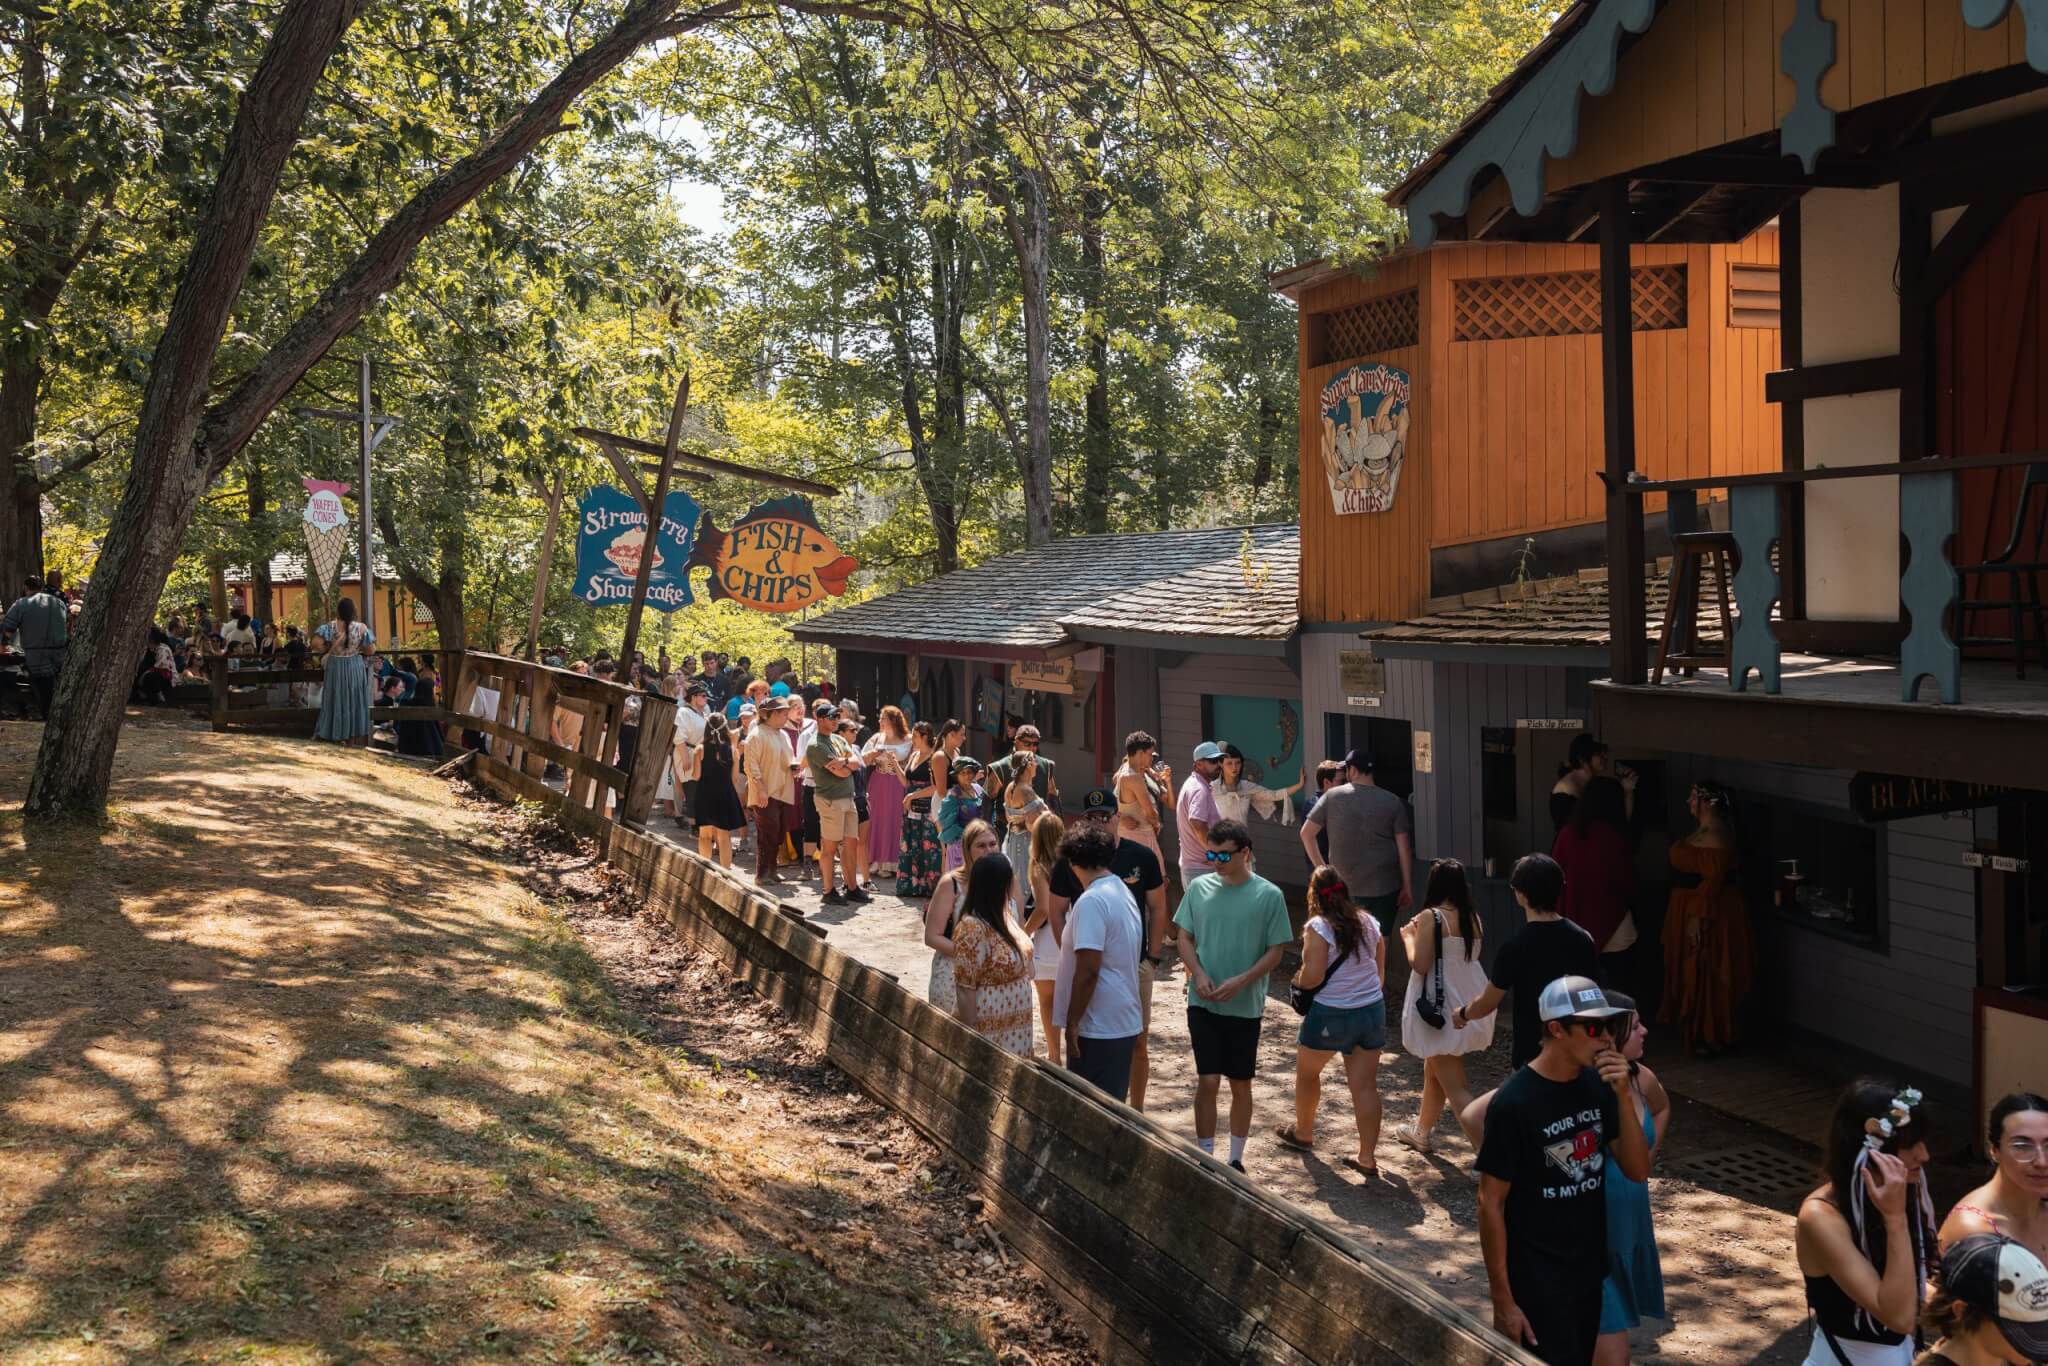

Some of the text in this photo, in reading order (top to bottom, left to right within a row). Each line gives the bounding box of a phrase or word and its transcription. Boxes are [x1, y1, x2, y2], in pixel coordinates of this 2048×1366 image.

[312, 498, 340, 512] WAFFLE
[312, 511, 337, 524] CONES
[585, 507, 689, 545] Strawrry
[728, 521, 805, 559] FISH
[765, 550, 784, 575] &
[586, 575, 685, 606] Shorcake
[723, 565, 812, 604] CHIPS
[1543, 1116, 1575, 1138] YOUR
[1543, 1187, 1556, 1199] IS
[1560, 1184, 1579, 1198] MY
